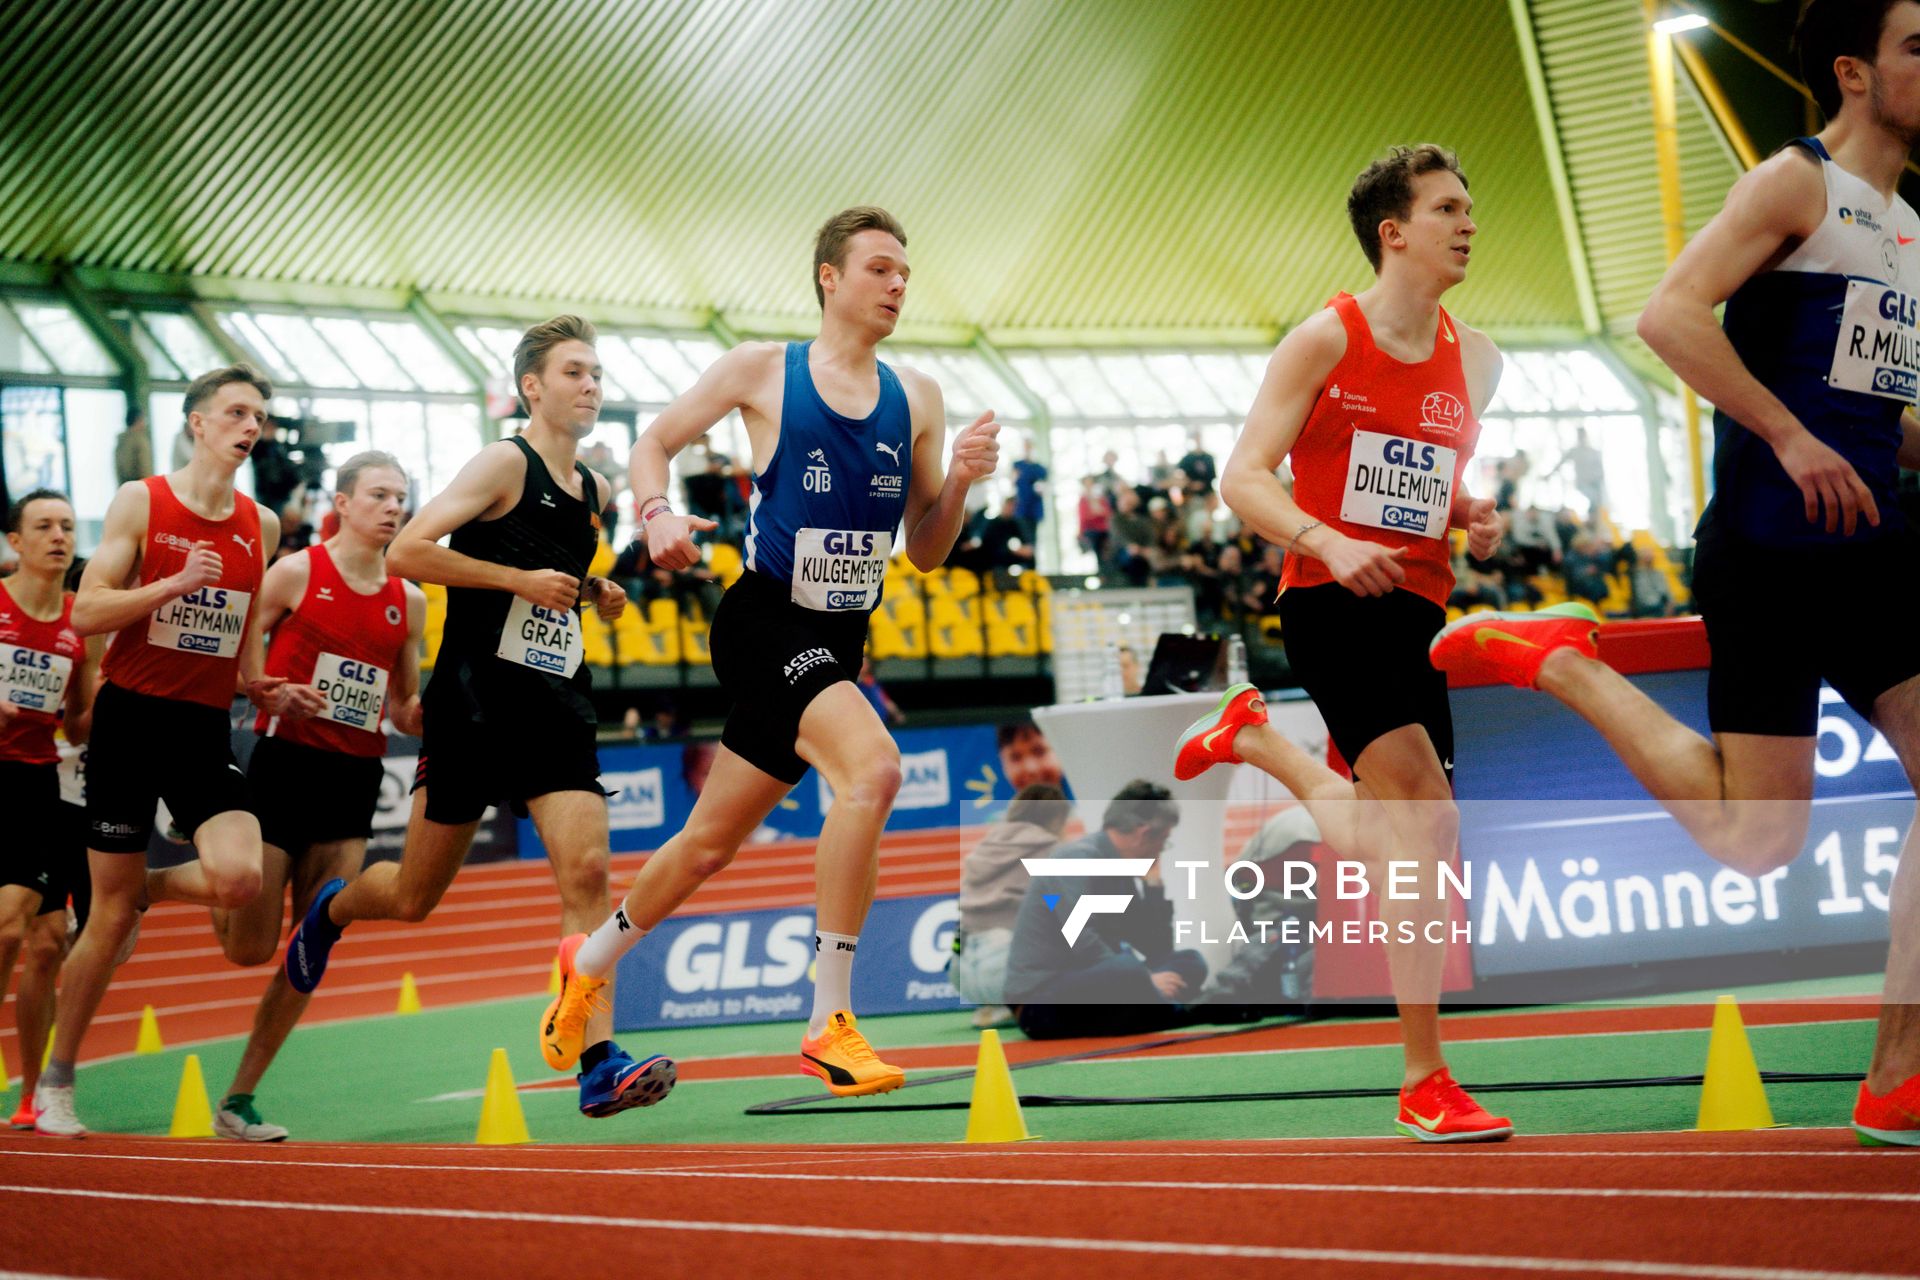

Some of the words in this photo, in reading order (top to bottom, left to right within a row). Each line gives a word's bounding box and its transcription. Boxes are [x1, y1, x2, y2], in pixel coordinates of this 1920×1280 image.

[1344, 391, 1368, 402] Taunus
[1341, 401, 1377, 413] Sparkasse
[869, 491, 901, 499] SPORTSHOP
[1354, 463, 1449, 508] DILLEMUTH
[1403, 511, 1427, 525] PLAN
[801, 557, 884, 585] KULGEMEYER
[845, 594, 866, 603] PLAN
[156, 604, 243, 635] L.HEYMANN
[195, 637, 218, 648] PLAN
[521, 619, 573, 652] GRAF
[541, 655, 565, 667] PLAN
[317, 678, 382, 714] RÖHRIG
[1479, 857, 1789, 945] Männer
[660, 999, 721, 1020] Parcels
[723, 997, 743, 1016] to
[744, 994, 803, 1017] People
